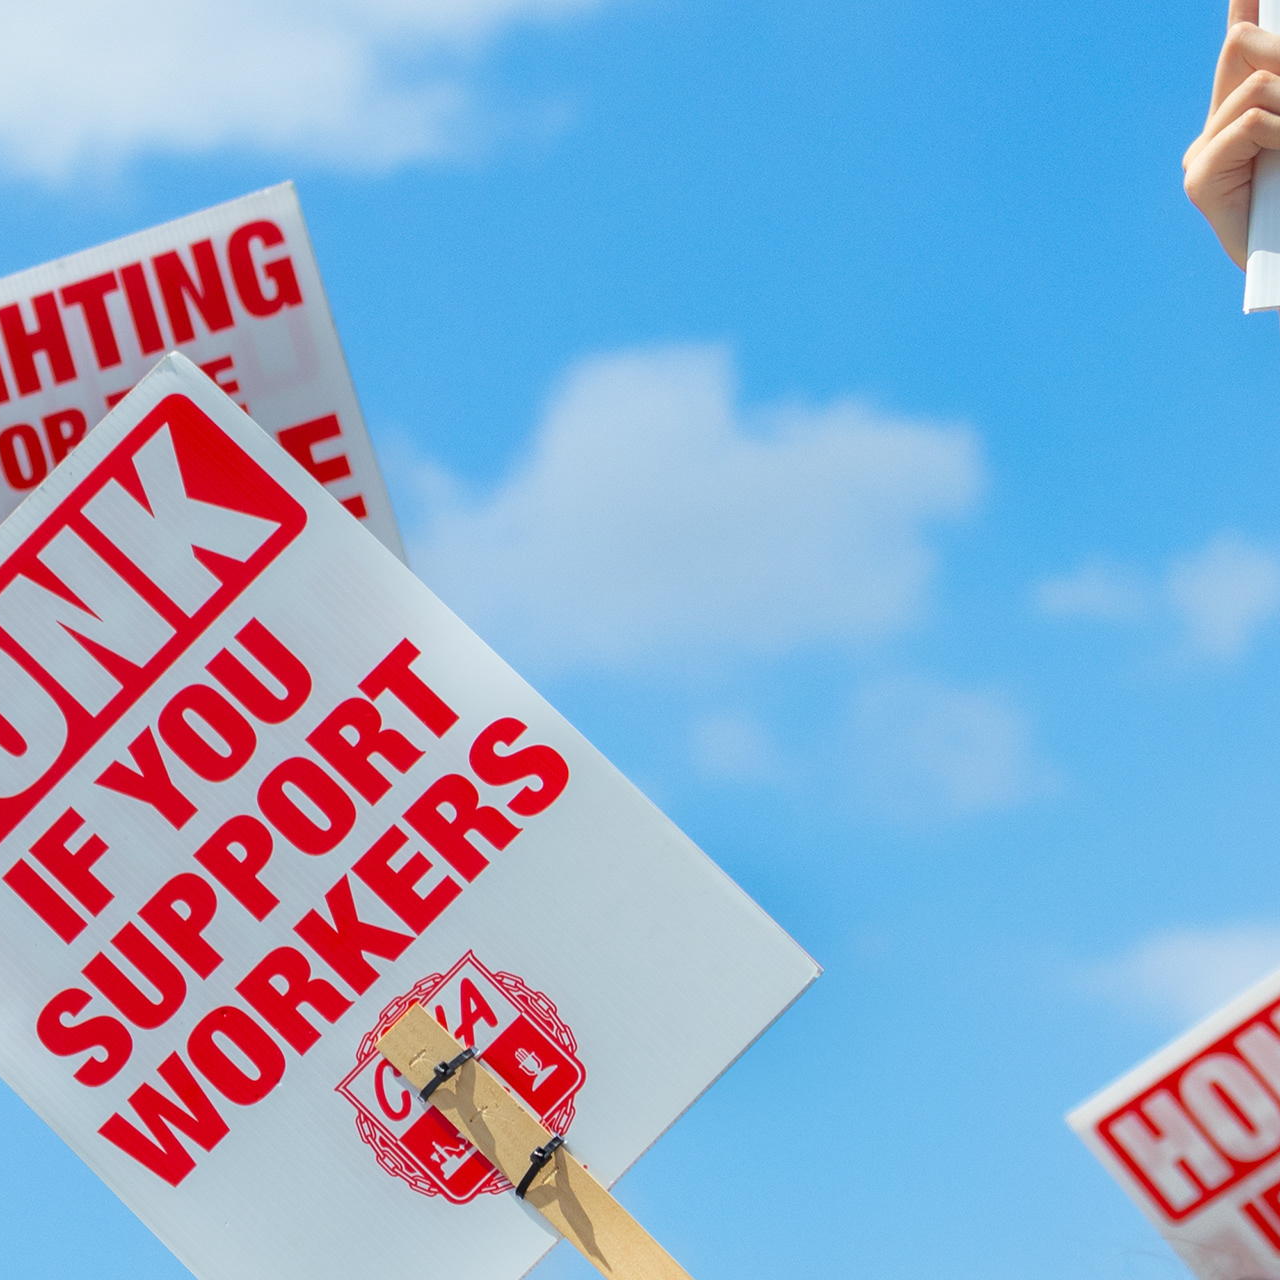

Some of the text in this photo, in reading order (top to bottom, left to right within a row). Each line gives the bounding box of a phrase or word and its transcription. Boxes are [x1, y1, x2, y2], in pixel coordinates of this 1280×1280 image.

[2, 616, 314, 944] IF YOU
[35, 637, 461, 1087] SUPPORT
[96, 716, 570, 1187] WORKERS
[374, 977, 499, 1121] CA
